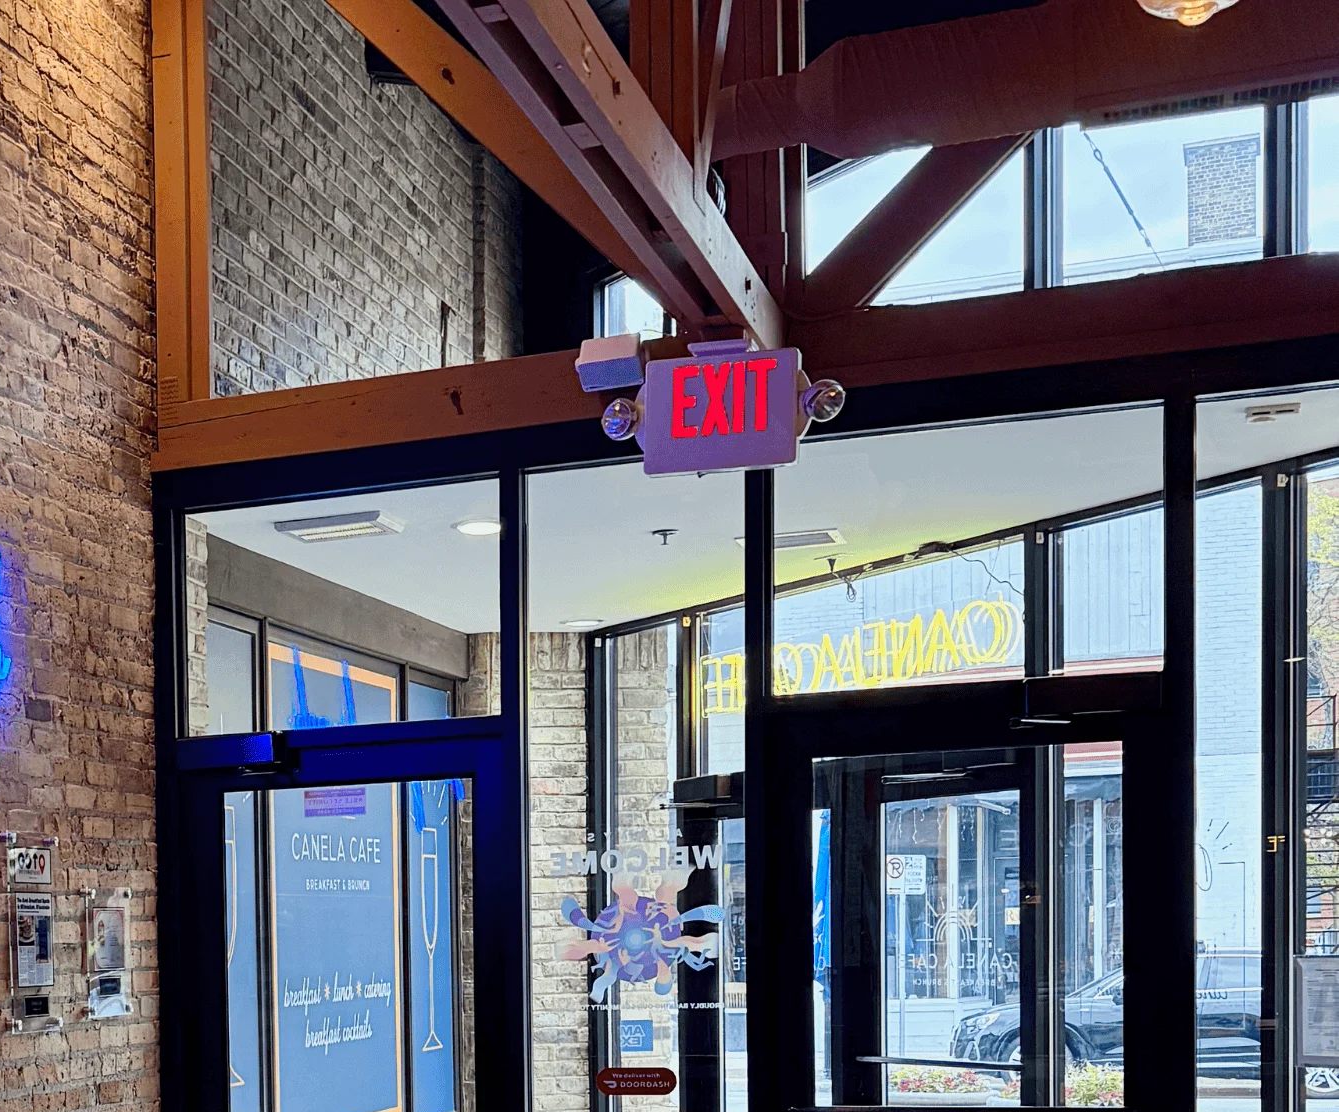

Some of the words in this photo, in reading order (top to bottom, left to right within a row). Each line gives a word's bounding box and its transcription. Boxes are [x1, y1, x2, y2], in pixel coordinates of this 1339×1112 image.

[670, 358, 778, 440] EXIT
[291, 832, 346, 862] CANELA
[349, 836, 381, 864] CAFE
[306, 879, 340, 890] BREAKFAST
[348, 880, 370, 891] BRUNCH
[283, 976, 321, 1016] breakfast
[332, 971, 354, 1003] lunch
[363, 971, 391, 1007] catering
[305, 1016, 341, 1056] breakfast
[342, 1009, 373, 1042] cocktails
